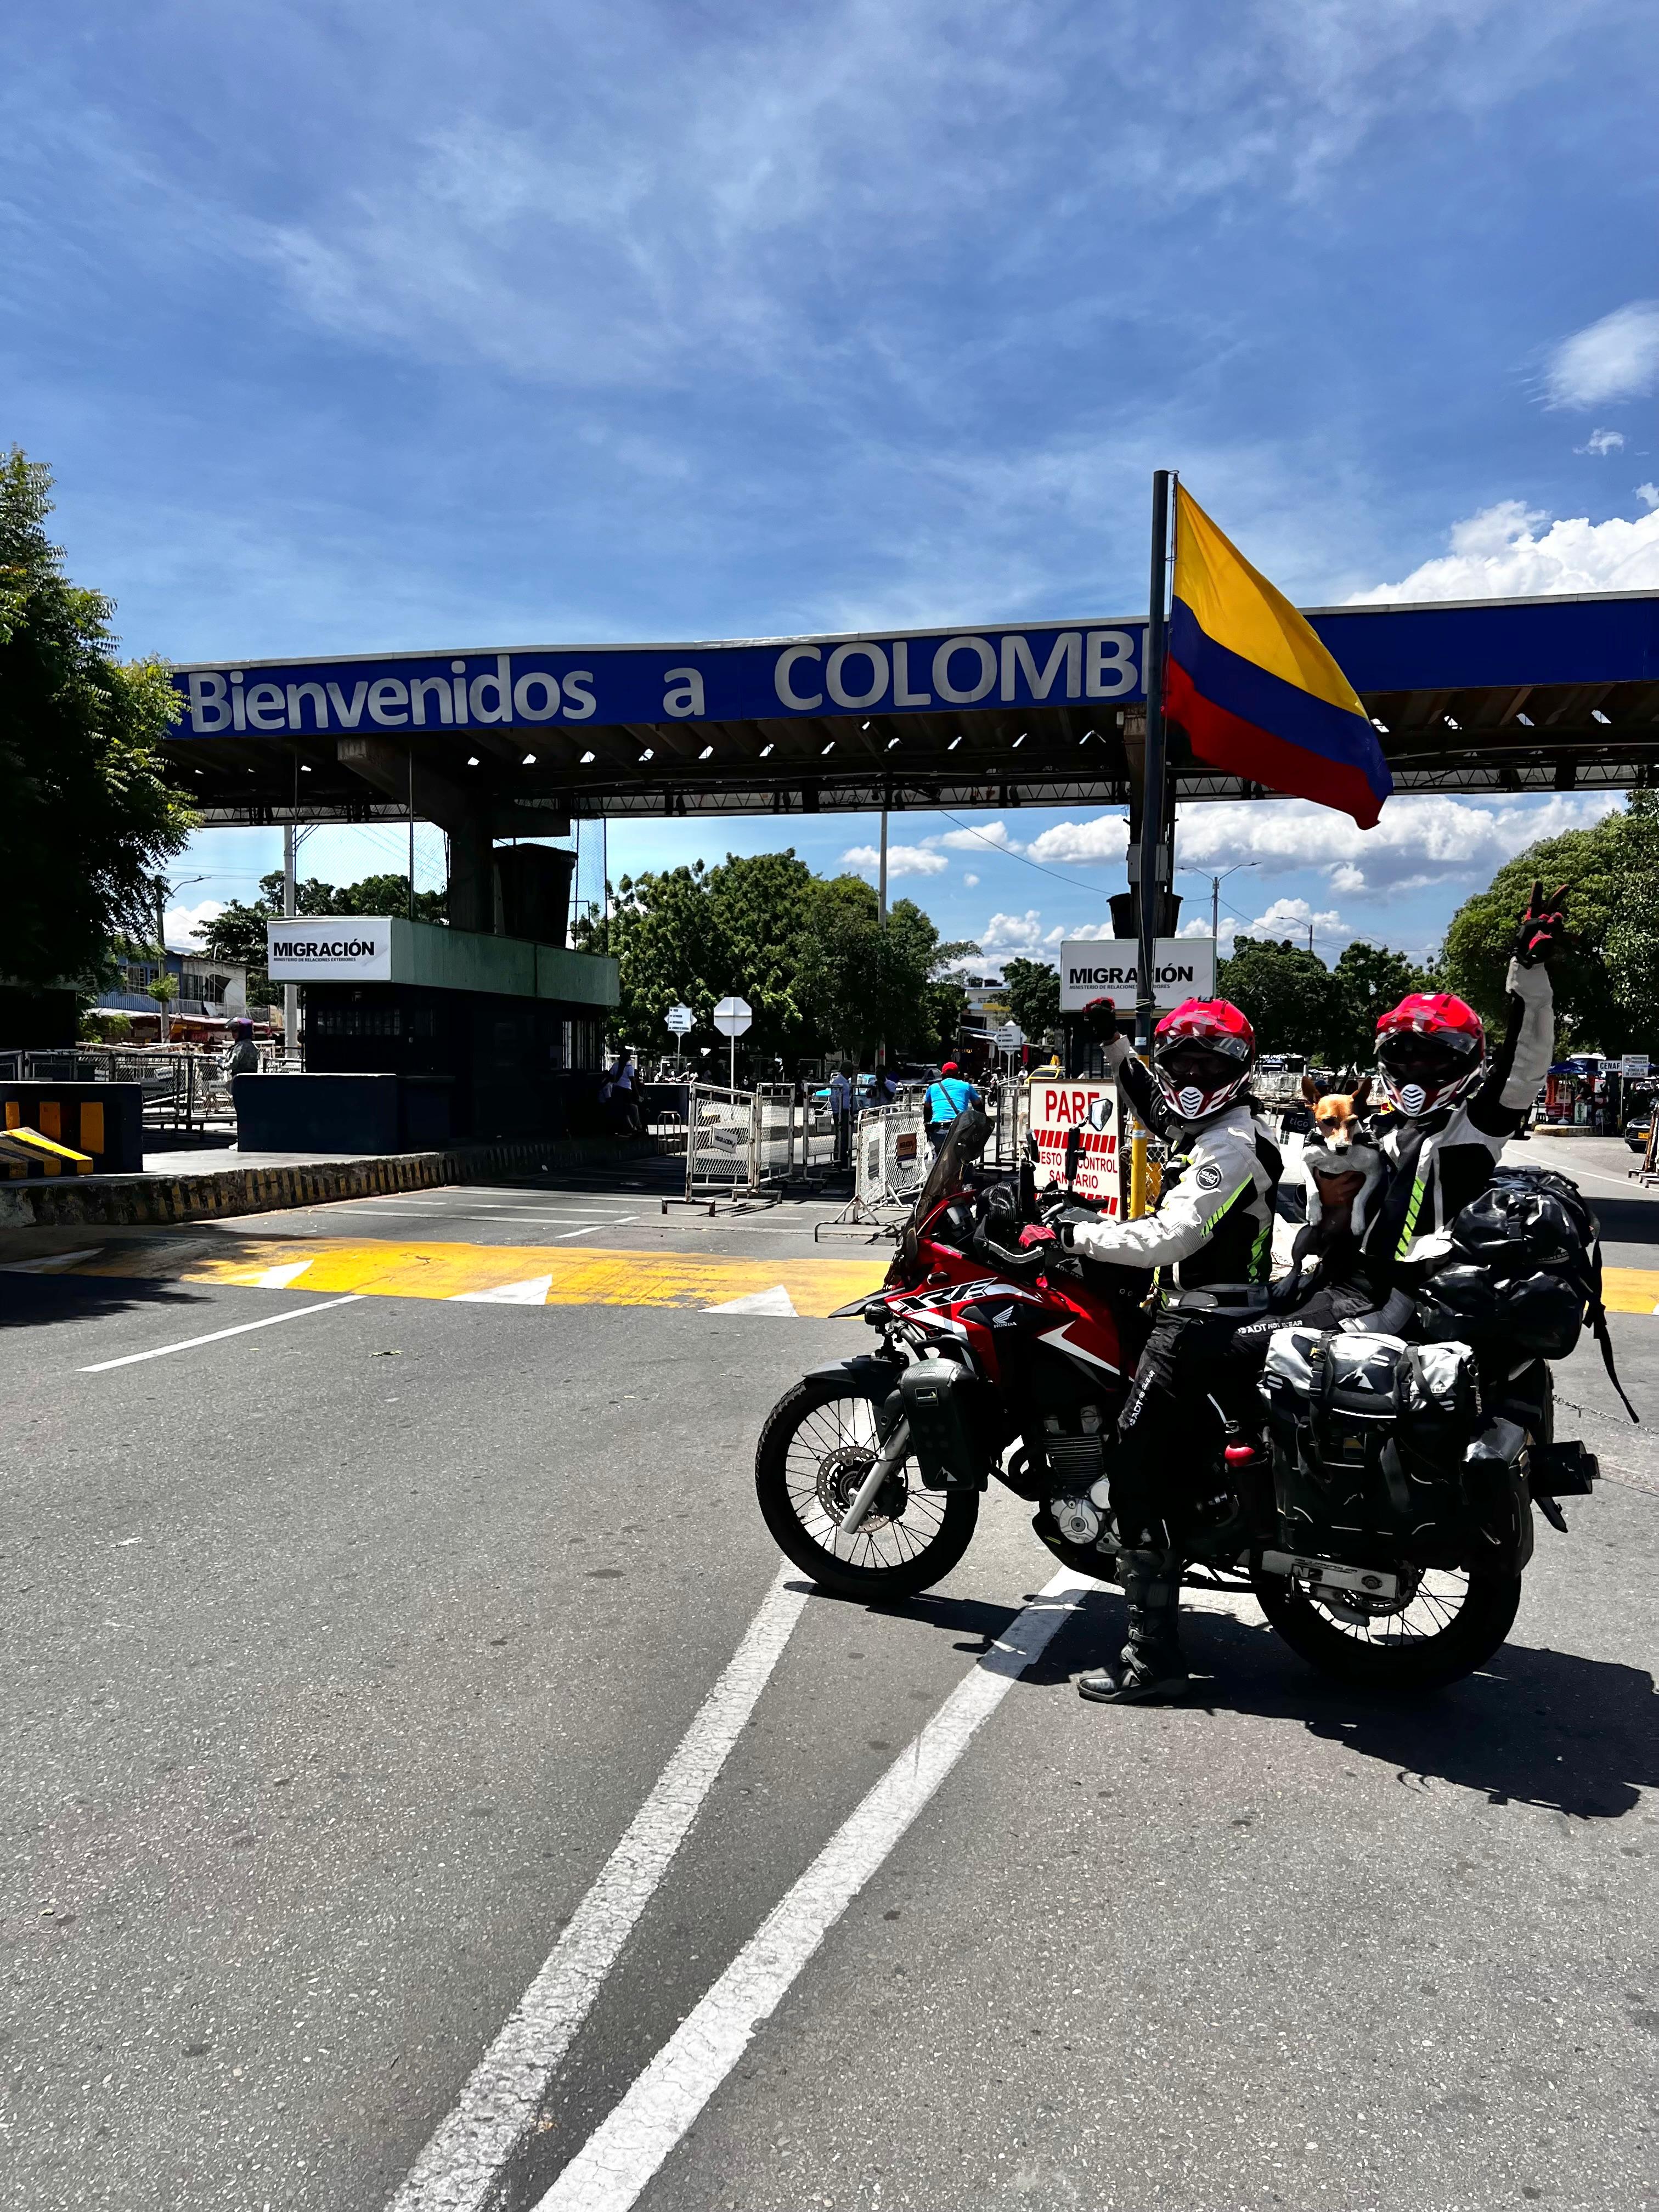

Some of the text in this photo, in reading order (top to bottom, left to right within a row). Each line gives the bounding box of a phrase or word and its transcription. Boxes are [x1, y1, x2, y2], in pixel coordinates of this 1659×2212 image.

[188, 654, 596, 732] Bienvenidos
[663, 667, 705, 718] a
[274, 938, 375, 957] MIGRACIÓN
[1069, 963, 1193, 984] MIGRAIÓN
[1049, 1170, 1098, 1189] SANARIO
